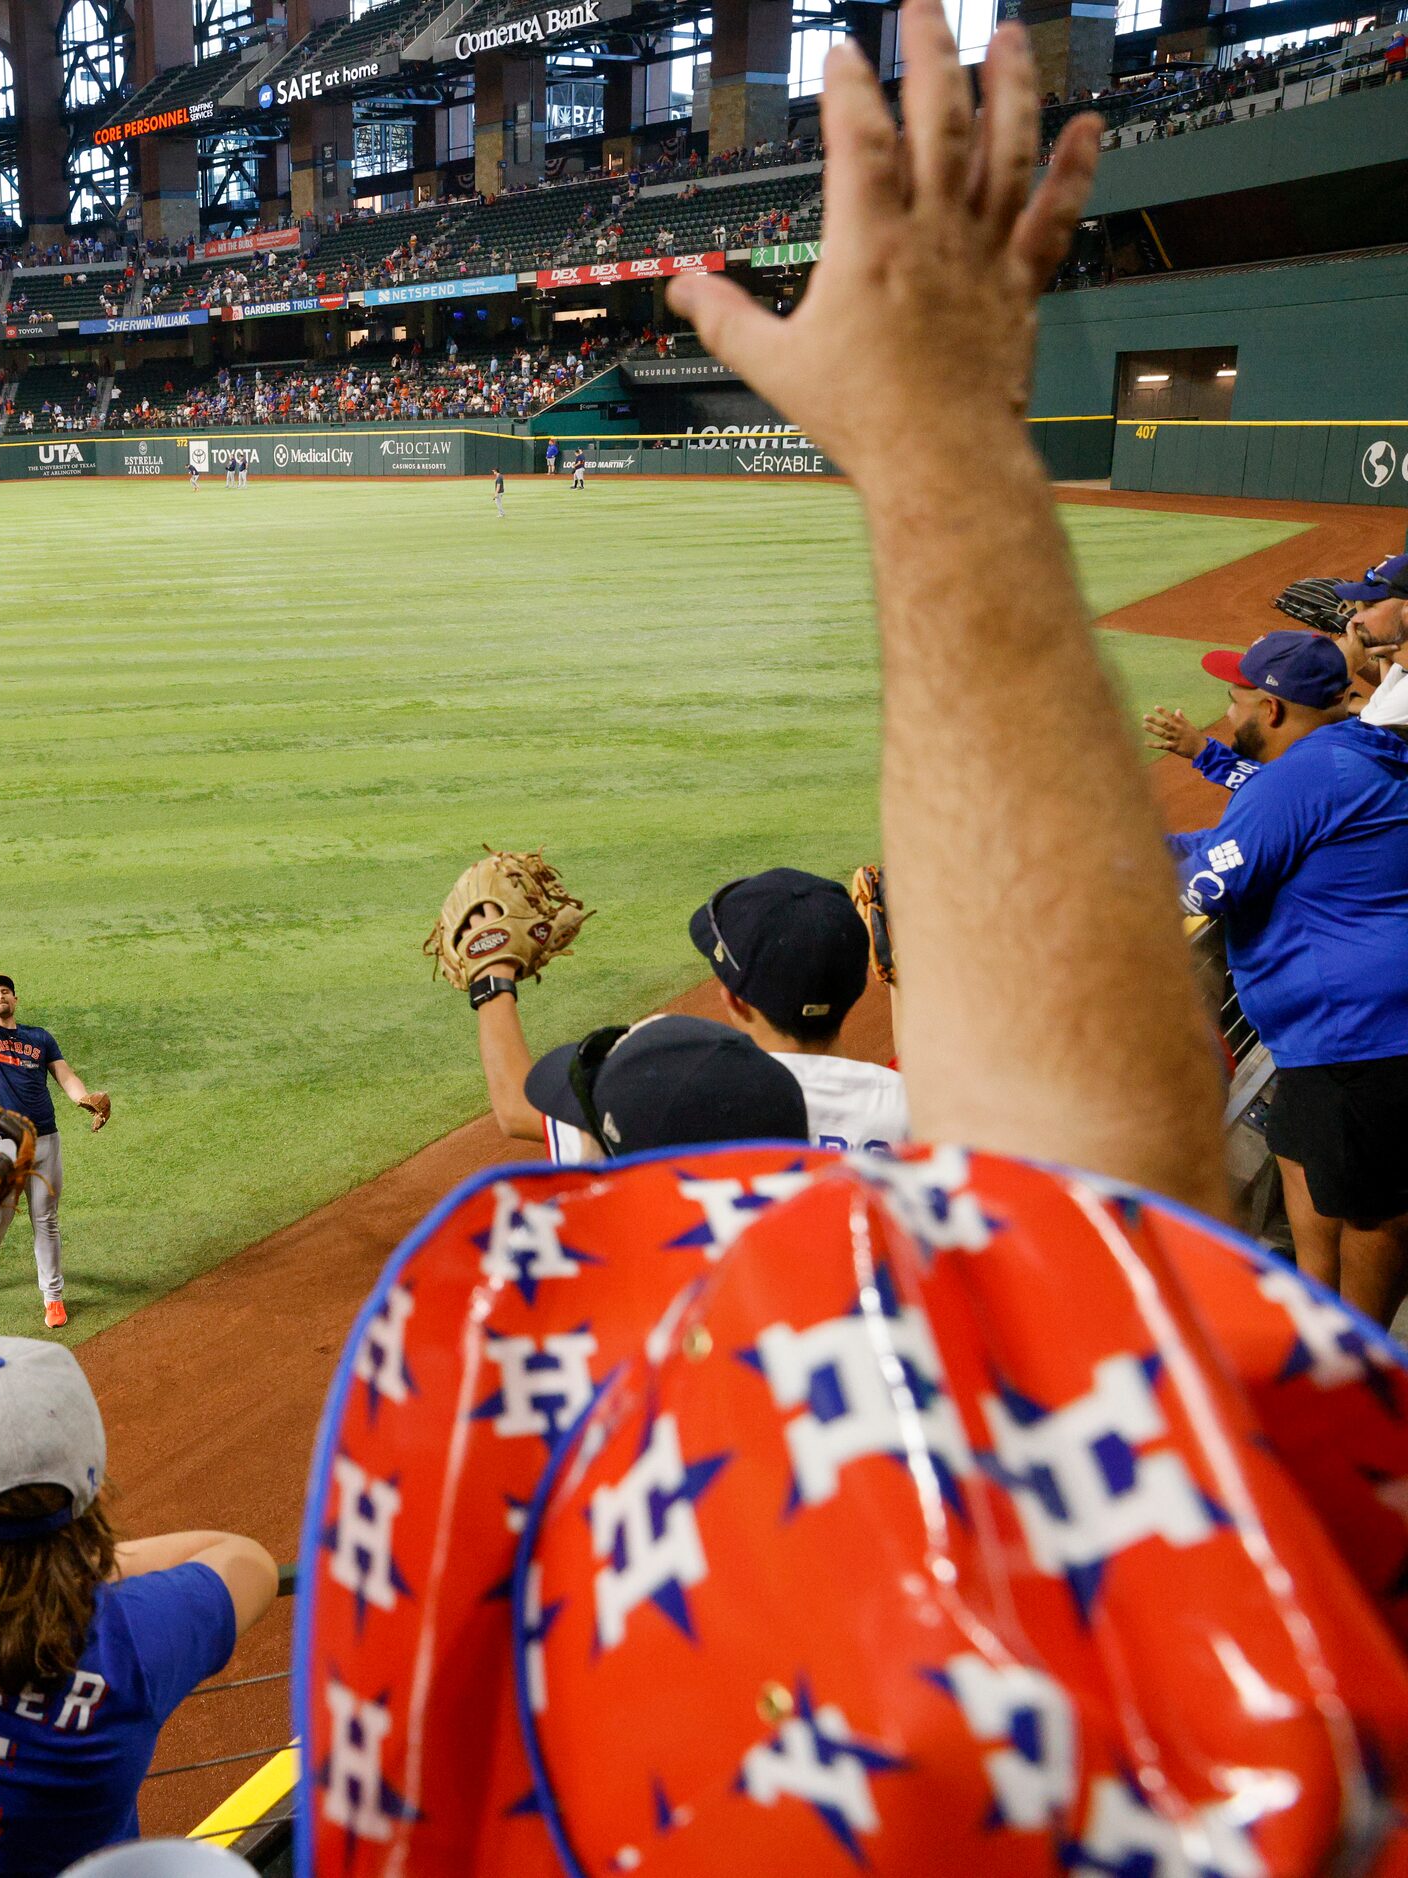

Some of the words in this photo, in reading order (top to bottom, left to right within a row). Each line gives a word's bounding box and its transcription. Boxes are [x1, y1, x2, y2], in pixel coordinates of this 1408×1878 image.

[546, 1, 600, 34] Bank
[277, 71, 322, 105] SAFE
[325, 70, 340, 87] at
[343, 63, 379, 83] home
[189, 101, 214, 114] STAFFING
[190, 109, 213, 122] SERVICES
[94, 125, 123, 145] CORE
[124, 107, 191, 138] PERSONNEL
[630, 258, 661, 273] DEX
[672, 254, 704, 268] DEX
[551, 267, 579, 281] DEX
[590, 263, 618, 277] DEX
[637, 270, 664, 279] imaging
[679, 266, 707, 274] imaging
[557, 279, 581, 287] imaging
[596, 275, 621, 283] imaging
[392, 284, 456, 300] NETSPEND
[244, 300, 291, 316] GARDENERS
[292, 297, 318, 311] TRUST
[18, 326, 43, 334] TOYOTA
[634, 368, 677, 377] ENSURING
[1135, 425, 1156, 440] 407
[176, 439, 188, 447] 372
[385, 440, 452, 454] CHOCTAW
[38, 444, 84, 464] UTA
[124, 456, 163, 465] ESTRELLA
[211, 449, 260, 464] TOYOTA
[291, 448, 330, 463] Medical
[331, 448, 354, 466] City
[128, 465, 160, 475] JALISCO
[486, 1333, 594, 1436] H
[332, 1453, 399, 1610] H
[324, 1676, 394, 1840] H
